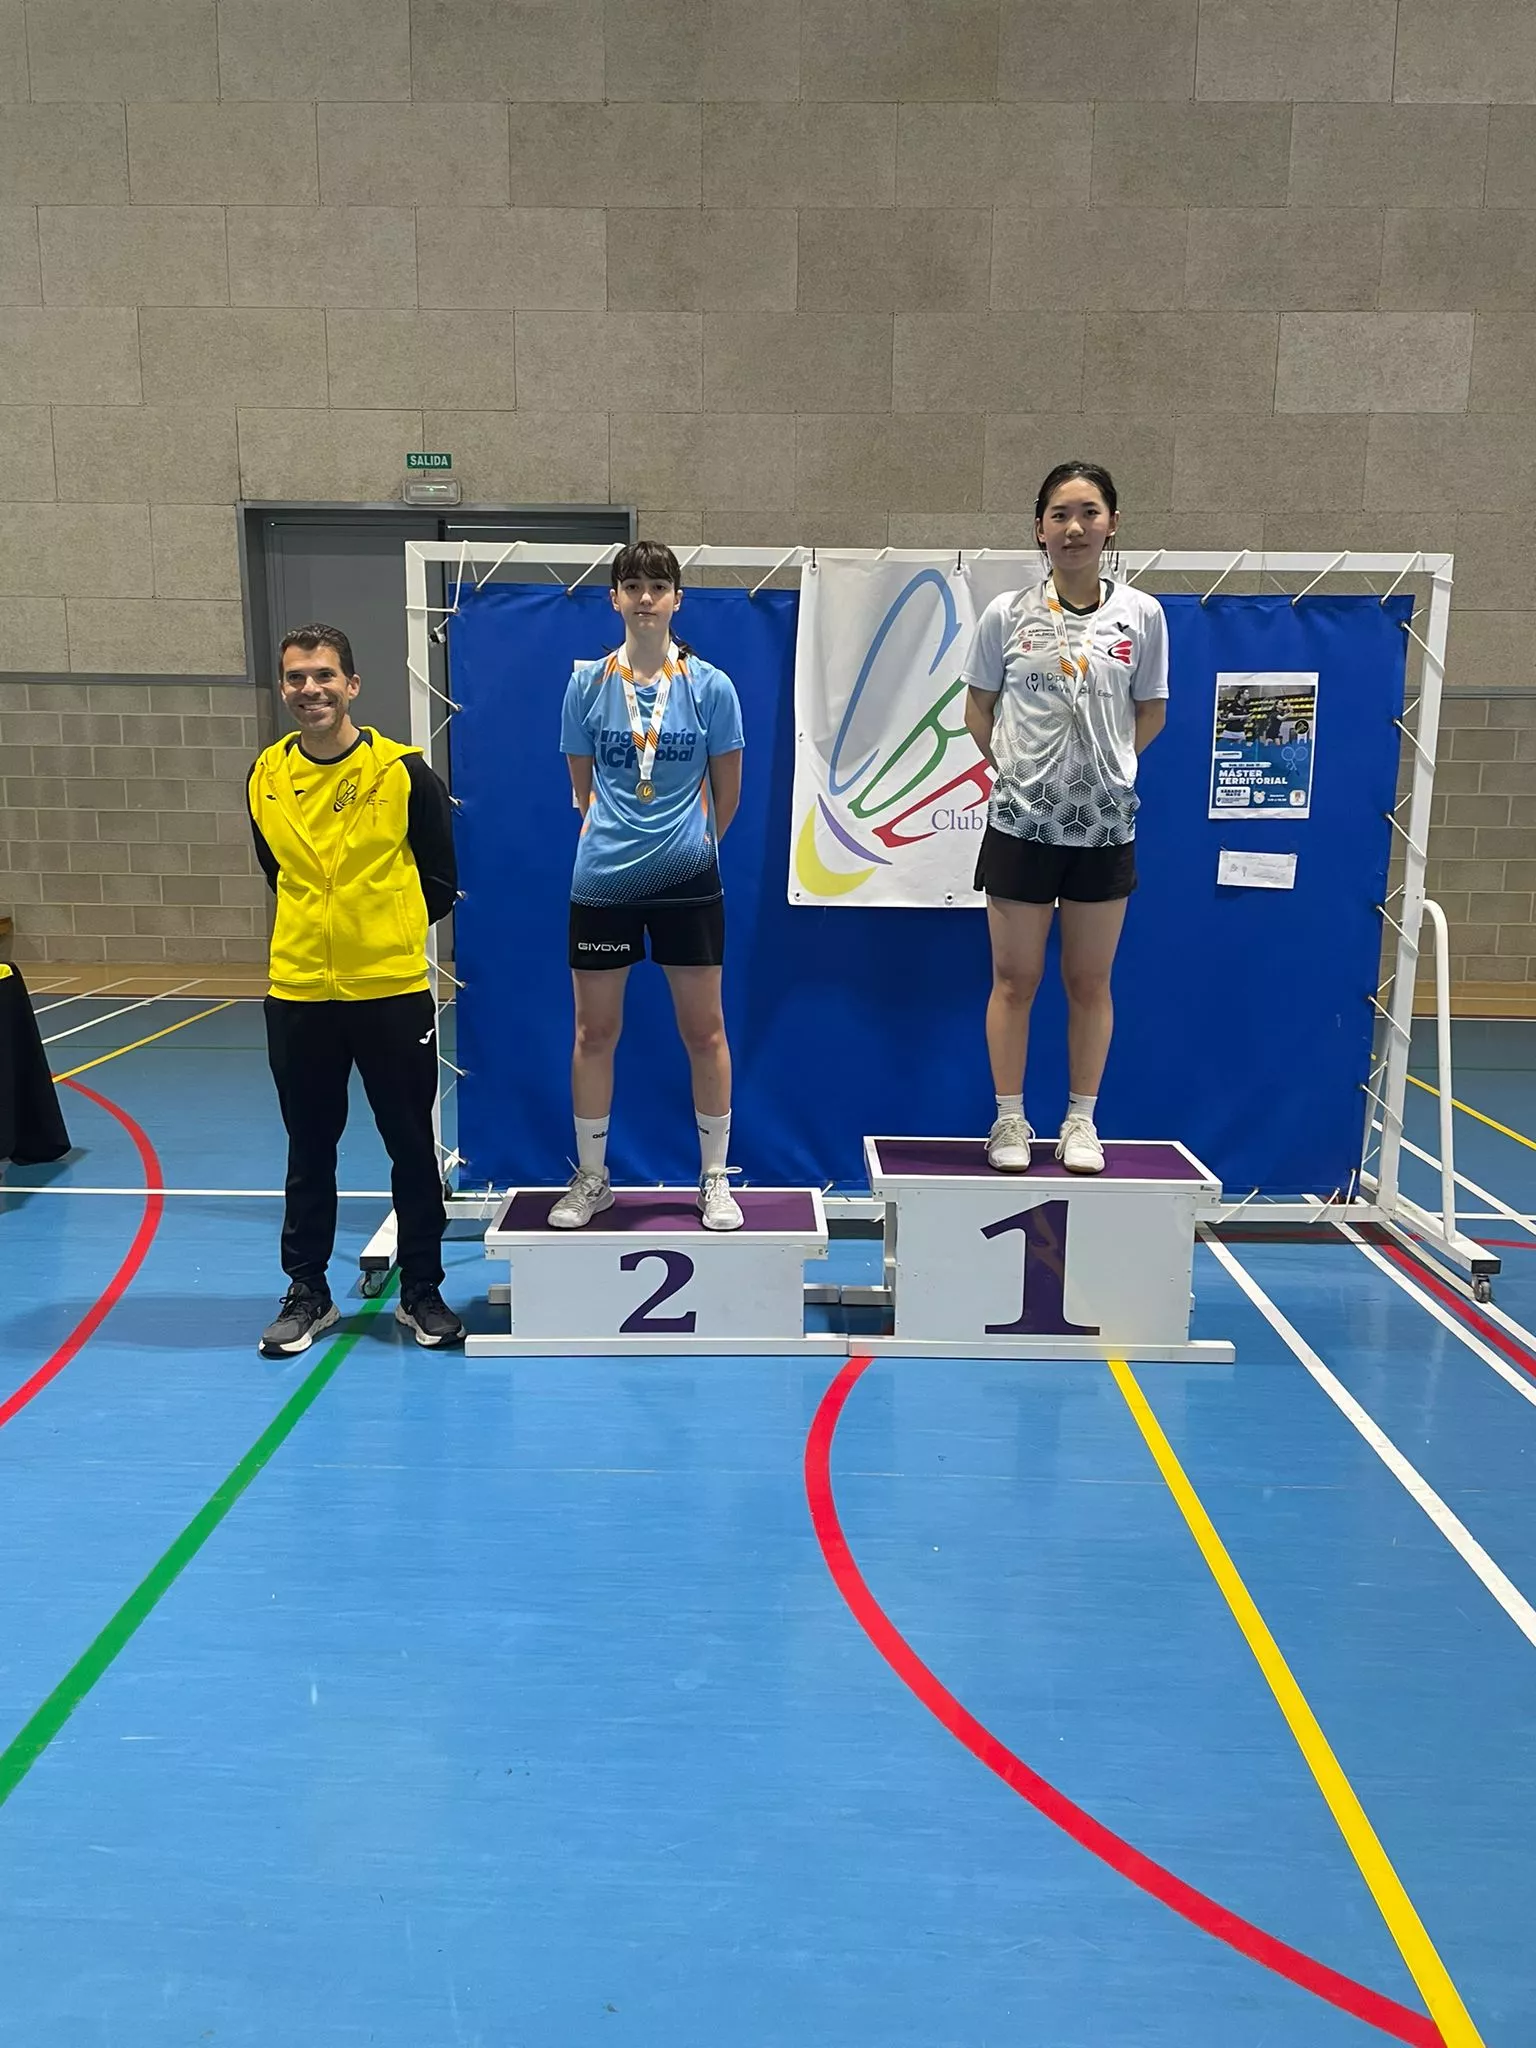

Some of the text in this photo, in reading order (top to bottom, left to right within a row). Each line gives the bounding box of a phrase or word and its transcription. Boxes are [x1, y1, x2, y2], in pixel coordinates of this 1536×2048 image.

[410, 455, 448, 466] SALIDA
[1219, 768, 1262, 777] MÁSTER
[1219, 777, 1288, 785] TERRITORIAL
[931, 809, 984, 831] Club
[578, 942, 630, 952] GIVOVA
[980, 1199, 1100, 1336] 1
[619, 1249, 697, 1333] 2
